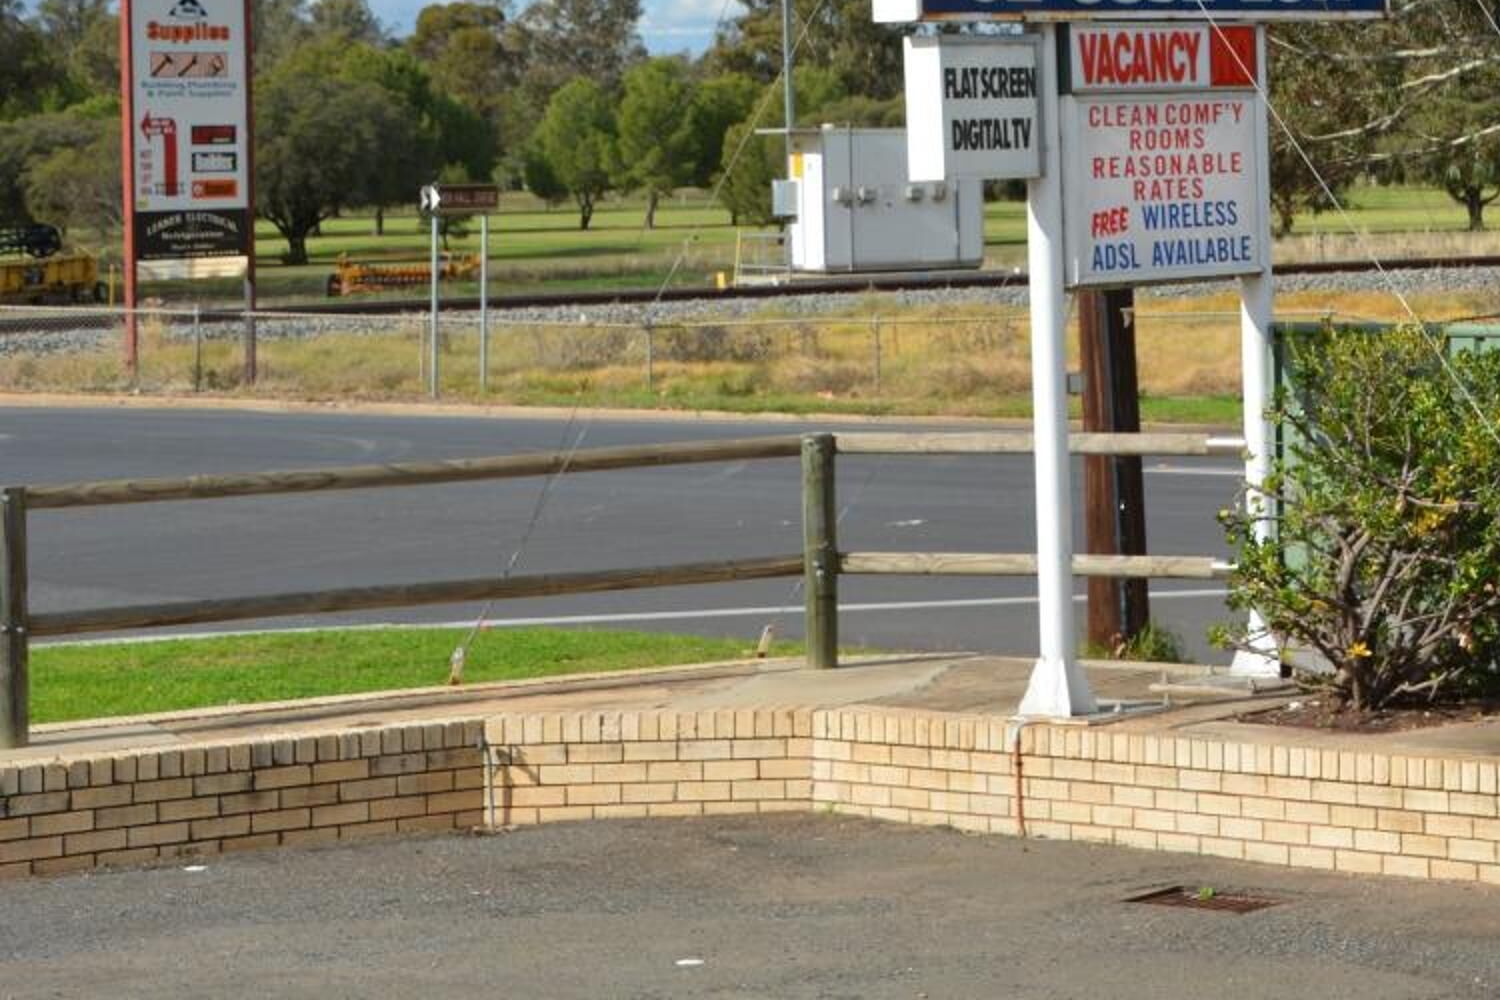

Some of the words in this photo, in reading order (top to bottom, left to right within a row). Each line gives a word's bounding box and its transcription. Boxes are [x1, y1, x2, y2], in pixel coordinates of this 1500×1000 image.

[147, 21, 230, 44] Supplies
[1079, 31, 1200, 85] VACANCY
[944, 67, 979, 99] FLAT
[981, 67, 1037, 99] SCREEN
[1089, 104, 1158, 127] CLEAN
[1165, 103, 1243, 125] COMF'Y
[952, 119, 1011, 150] DIGITAL
[1012, 118, 1031, 149] TV
[1130, 128, 1205, 150] ROOMS
[1093, 152, 1242, 179] REASONABLE
[1134, 178, 1204, 201] RATES
[1092, 206, 1129, 238] FREE
[1142, 201, 1238, 230] WIRELESS
[1093, 243, 1141, 271] ADSL
[1152, 235, 1252, 267] AVAILABLE
